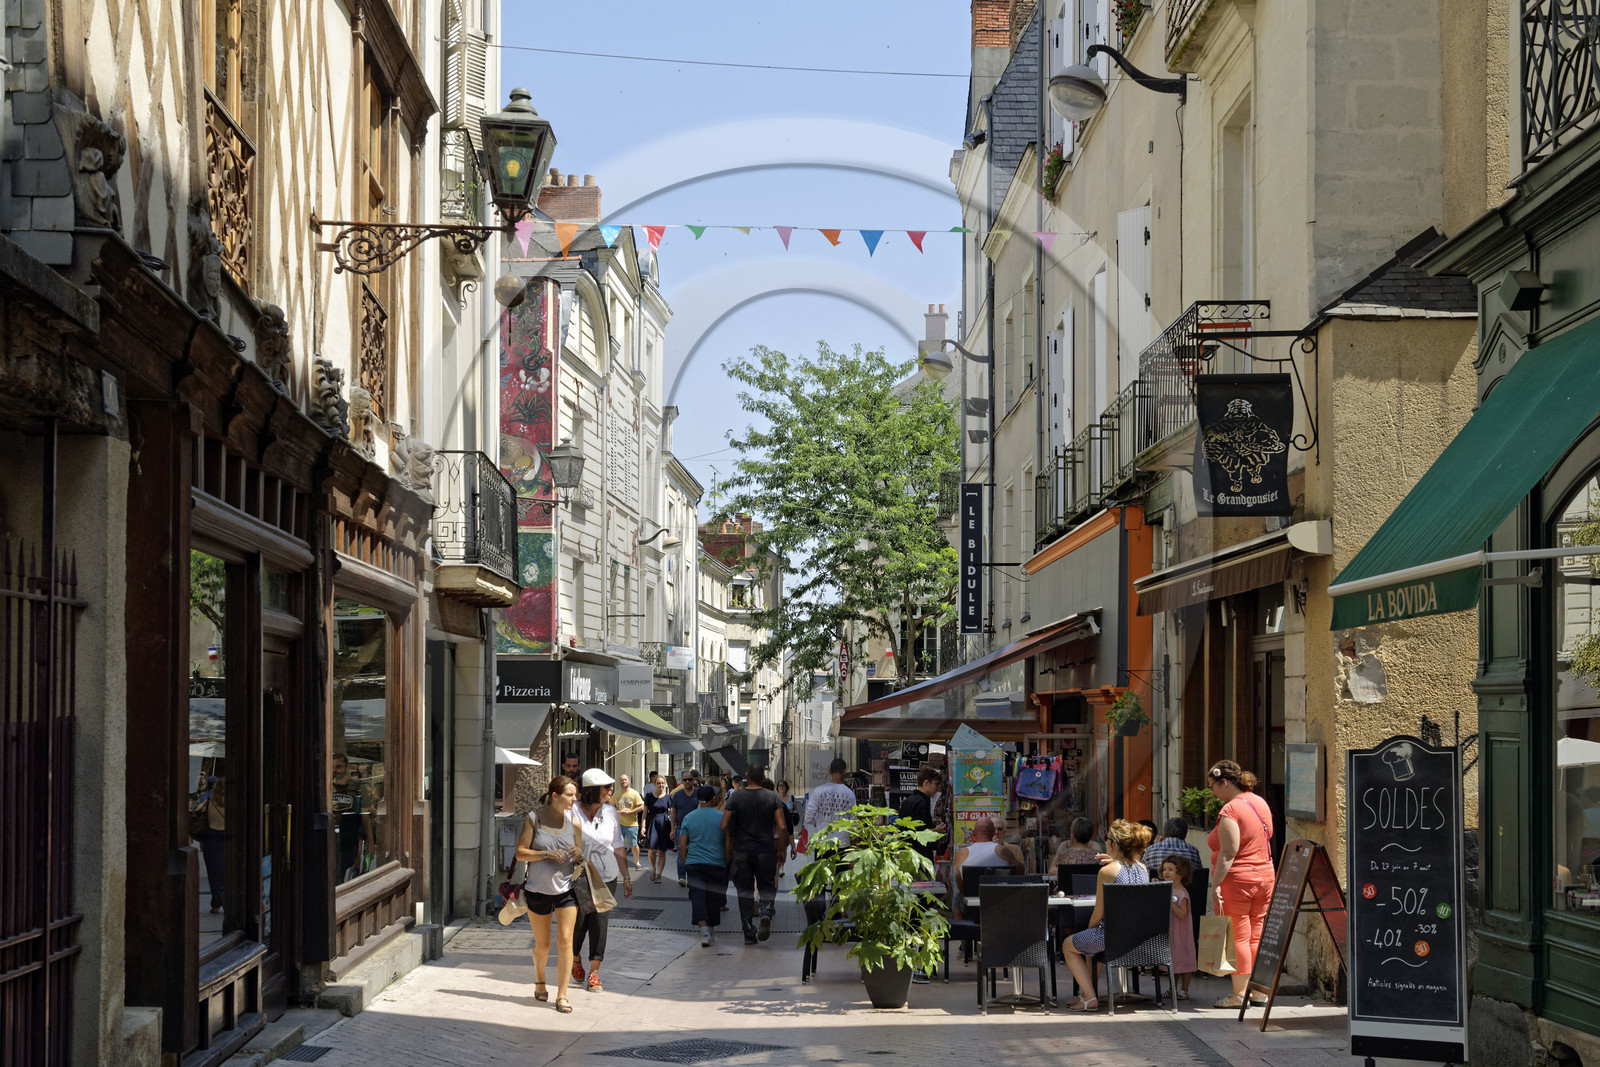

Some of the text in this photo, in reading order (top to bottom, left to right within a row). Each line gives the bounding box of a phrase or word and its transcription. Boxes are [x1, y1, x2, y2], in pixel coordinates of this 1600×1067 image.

[1201, 488, 1279, 508] Le Grandgousier
[967, 506, 976, 616] LE BIDULE
[1367, 581, 1438, 621] LA BOVIDA
[503, 685, 551, 697] Pizzeria
[1363, 787, 1446, 830] SOLDES
[1412, 862, 1418, 870] 7
[1366, 928, 1402, 948] -40%
[1414, 924, 1437, 935] -30%
[1367, 977, 1392, 989] Articles
